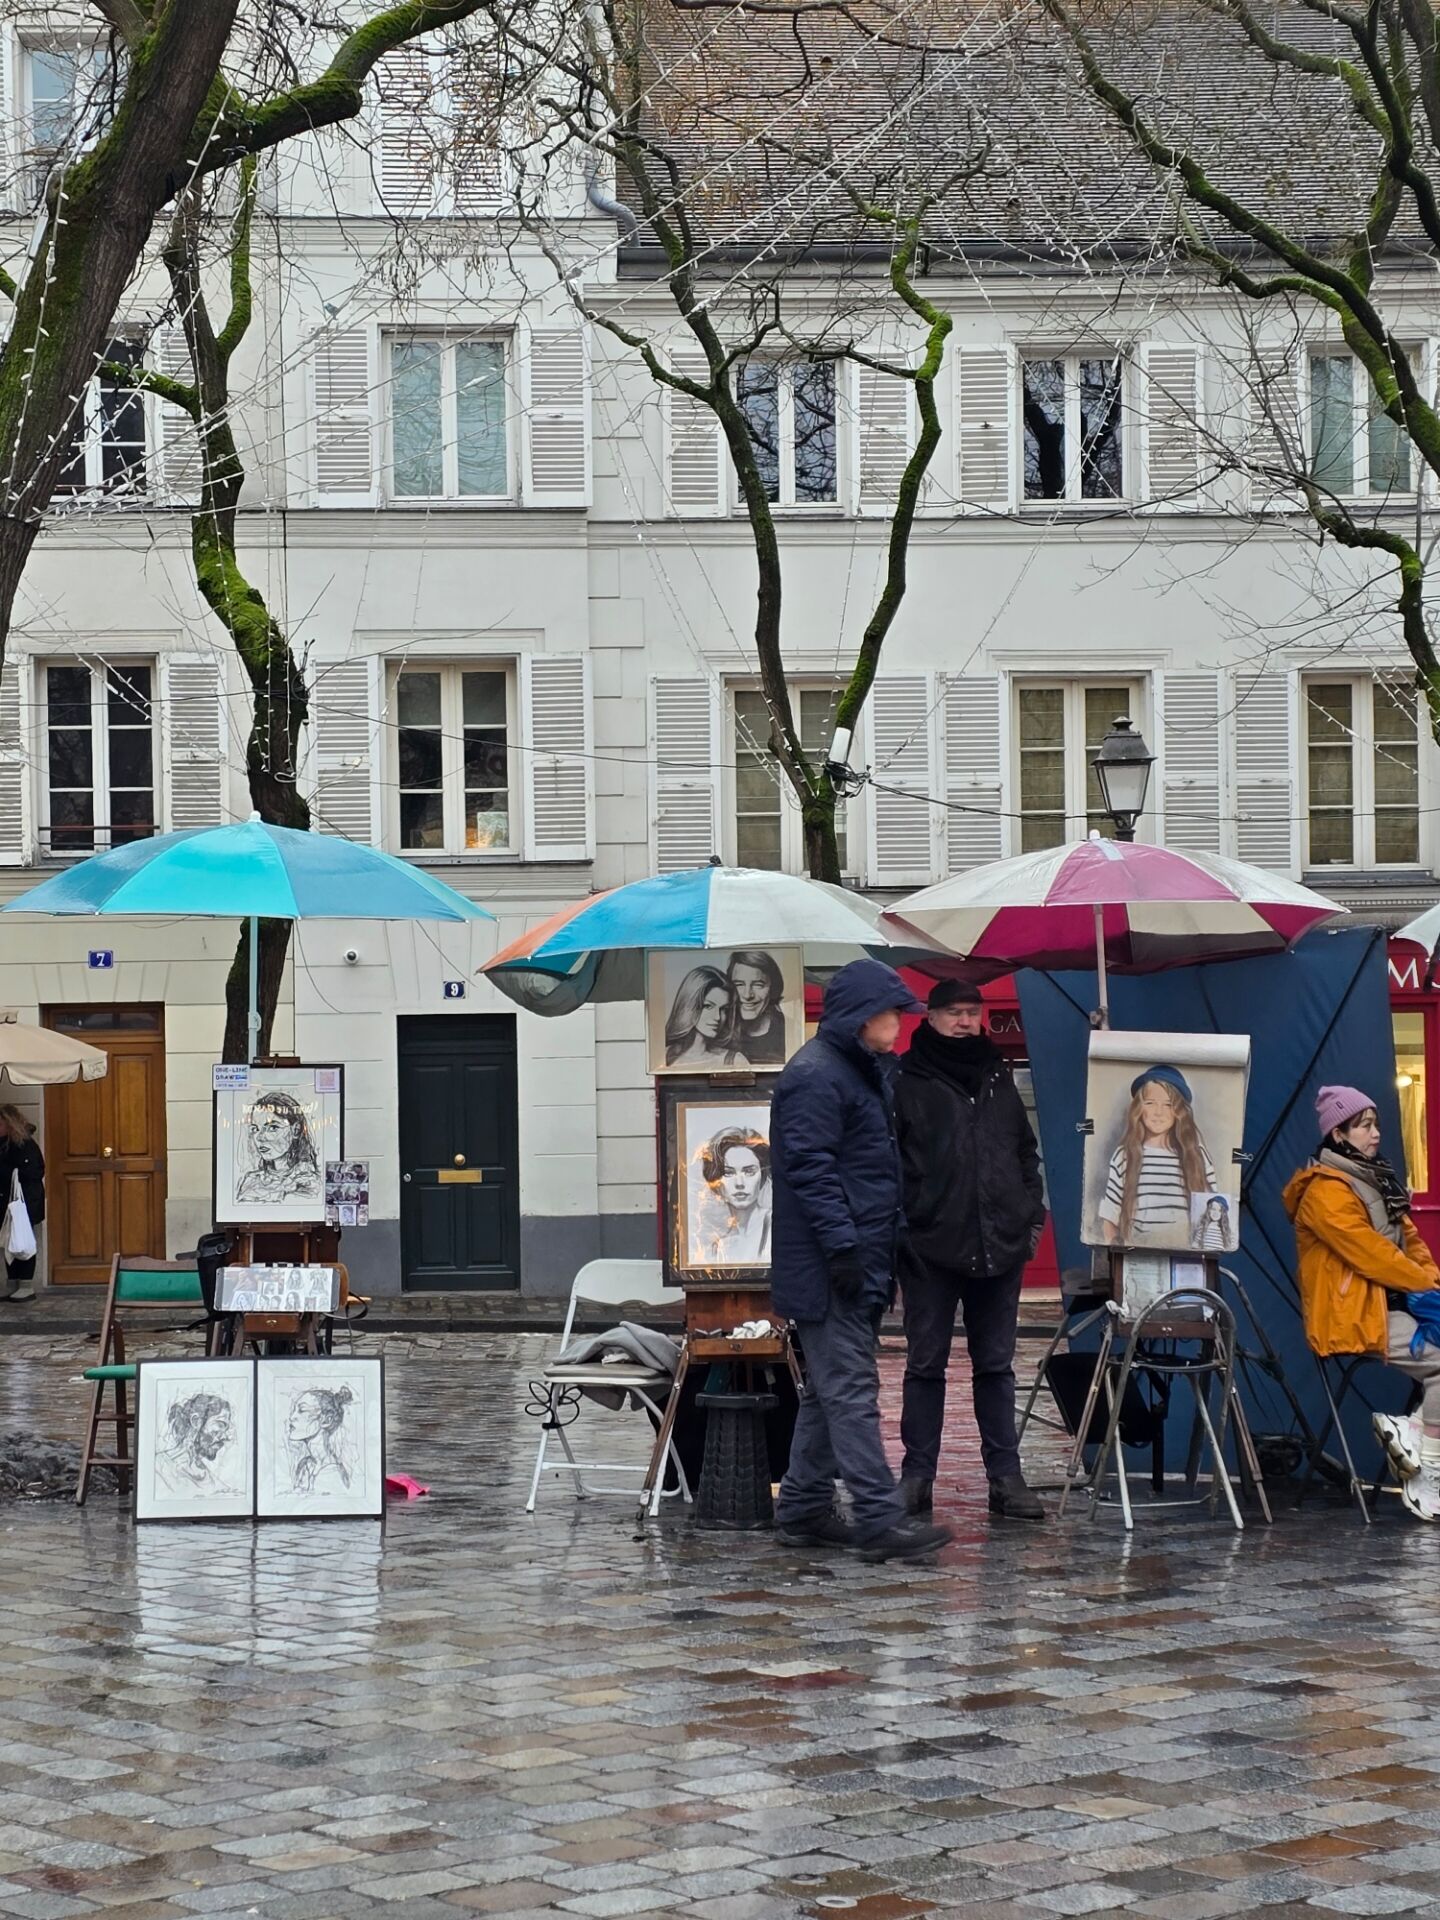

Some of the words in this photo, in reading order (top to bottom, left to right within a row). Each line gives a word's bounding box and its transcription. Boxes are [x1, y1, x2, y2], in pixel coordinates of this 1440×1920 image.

[96, 952, 105, 967] 7
[1388, 958, 1440, 989] M
[450, 983, 459, 997] 9
[989, 1014, 1021, 1034] GA
